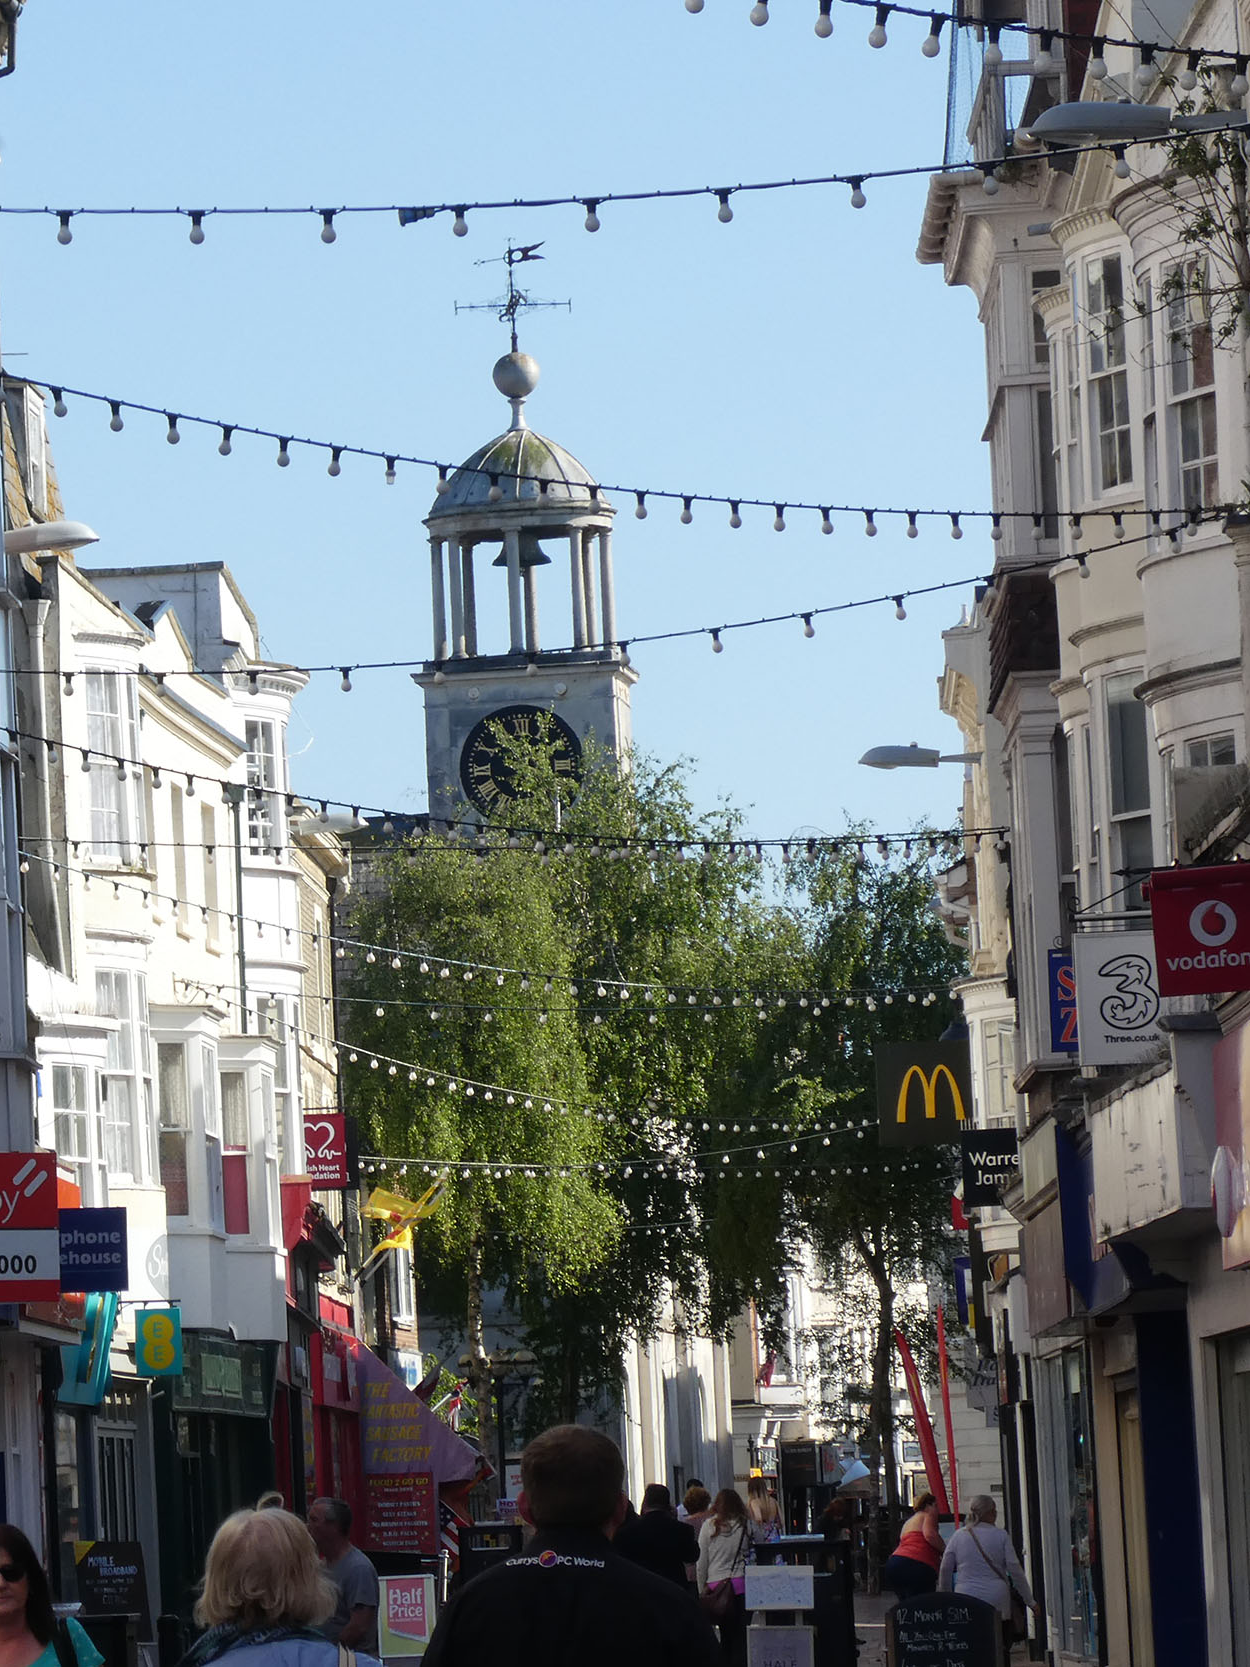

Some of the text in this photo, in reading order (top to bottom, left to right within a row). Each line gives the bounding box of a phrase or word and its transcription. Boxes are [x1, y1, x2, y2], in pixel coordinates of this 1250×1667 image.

[1098, 954, 1160, 1030] 3
[1104, 1033, 1160, 1043] Three.co.uk
[319, 1164, 340, 1172] Heart
[365, 1382, 391, 1398] THE
[366, 1424, 422, 1442] SAUSAGE
[372, 1446, 432, 1464] FACTORY
[557, 1555, 572, 1566] PC
[572, 1557, 605, 1568] World
[390, 1588, 422, 1605] Half
[390, 1605, 423, 1618] Price
